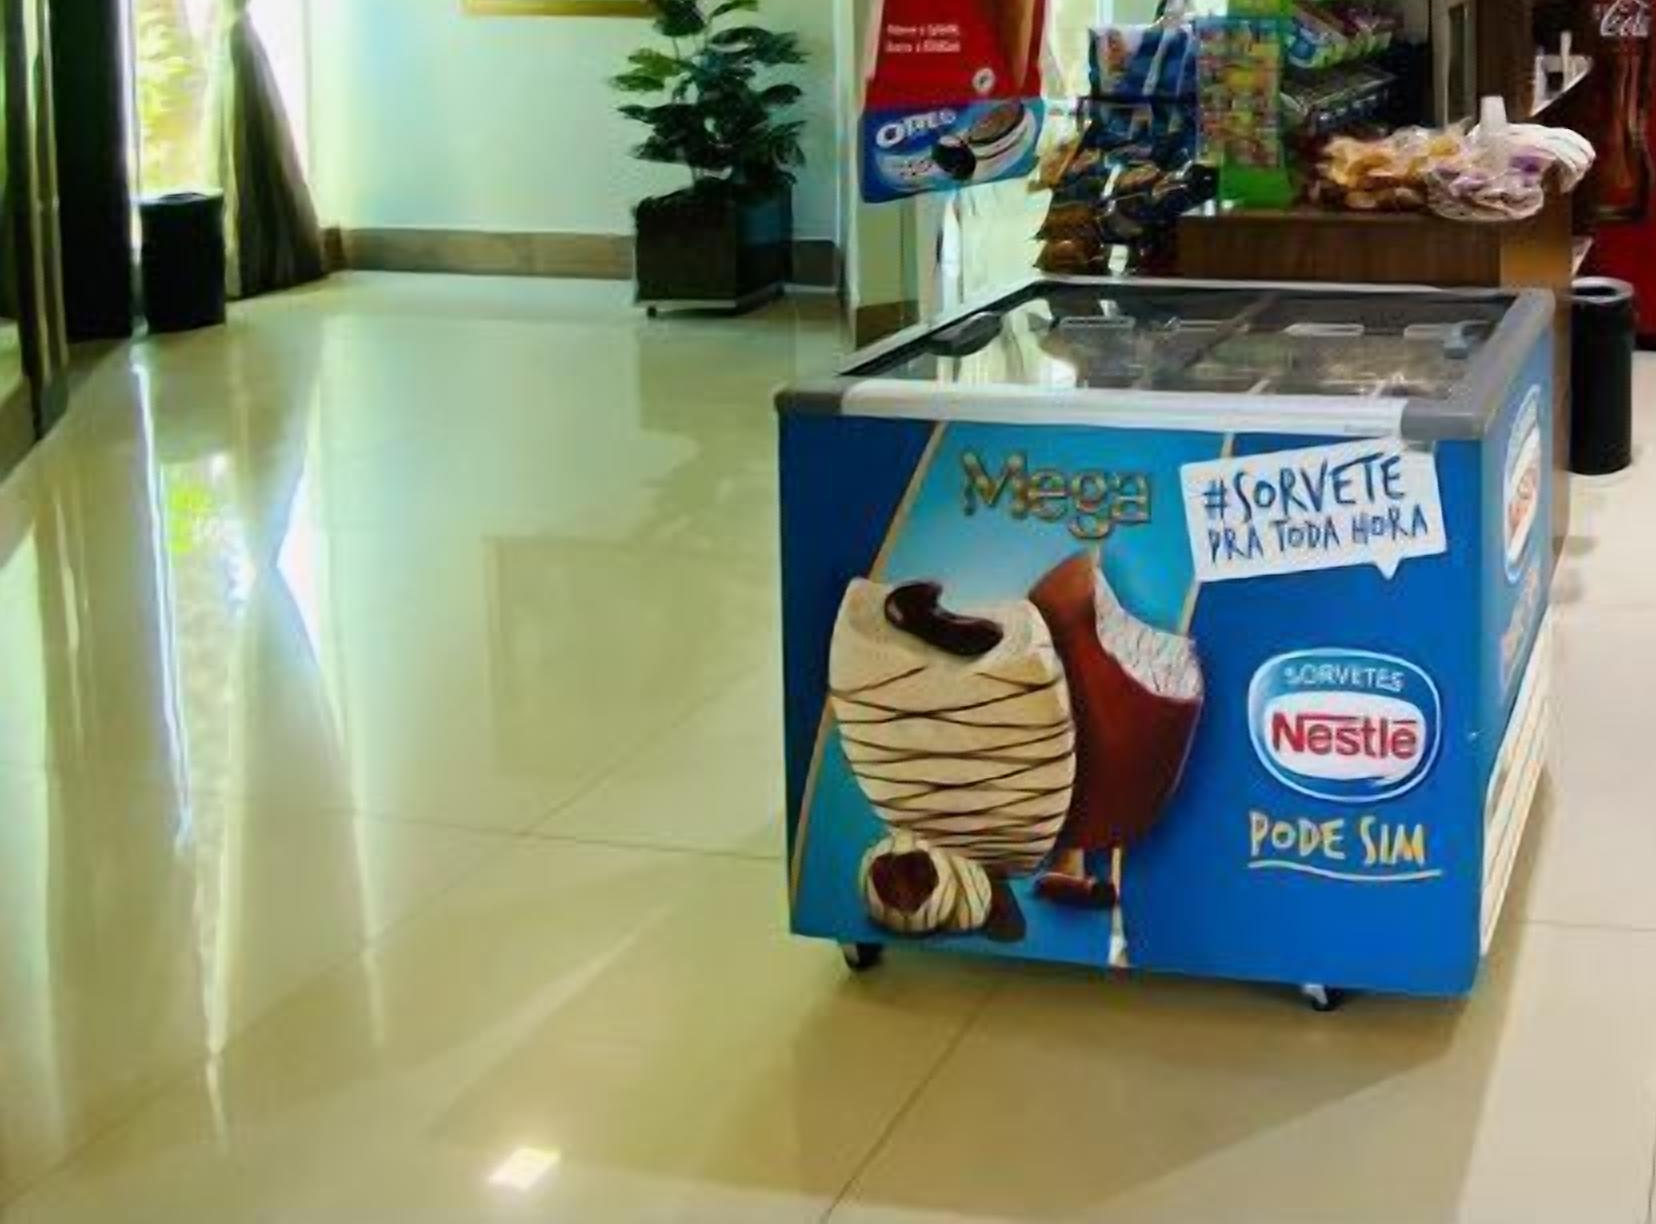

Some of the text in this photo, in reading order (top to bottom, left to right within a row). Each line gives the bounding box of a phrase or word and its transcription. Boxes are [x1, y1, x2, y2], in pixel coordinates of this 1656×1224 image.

[958, 450, 1152, 540] Mega
[1203, 451, 1407, 520] #SORVETE
[1207, 503, 1428, 563] PRA TODA HORA
[1283, 662, 1405, 692] SORVETES
[1249, 810, 1426, 866] PODE SIM
